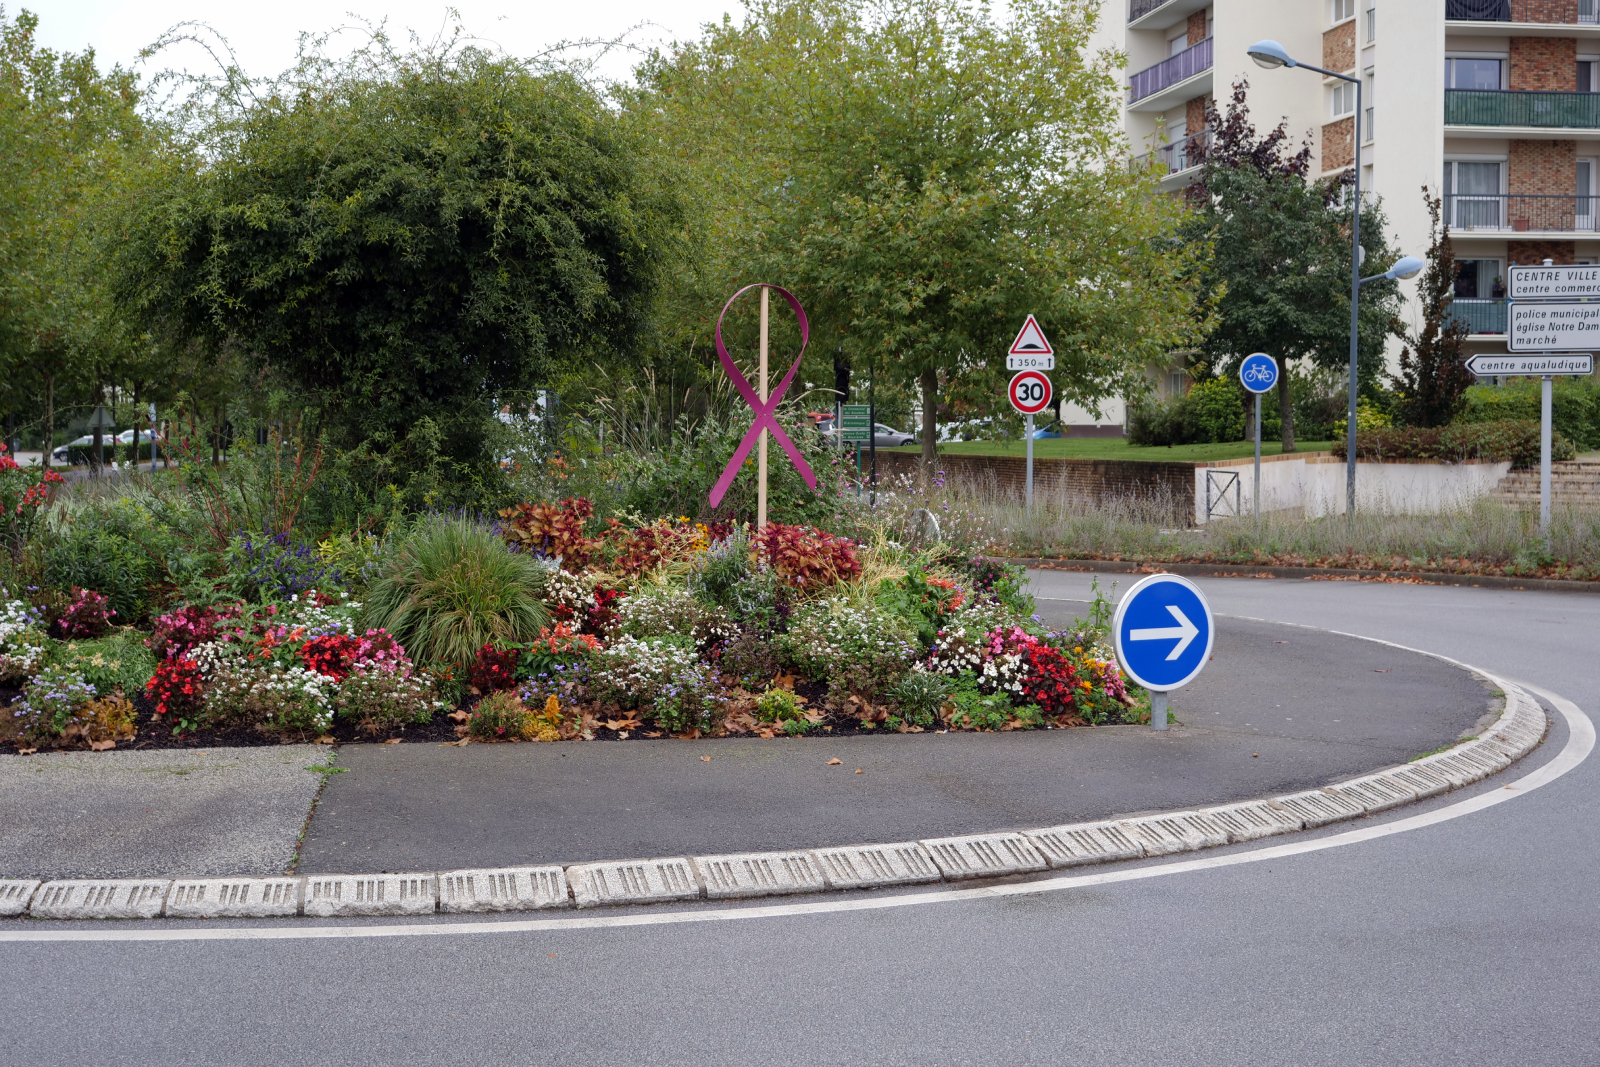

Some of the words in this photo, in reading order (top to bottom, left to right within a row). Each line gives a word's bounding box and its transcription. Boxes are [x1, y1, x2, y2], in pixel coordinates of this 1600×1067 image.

[1516, 271, 1560, 281] CENTRE
[1567, 270, 1598, 281] VILLE
[1516, 285, 1550, 294] centre
[1516, 309, 1547, 321] police
[1550, 308, 1600, 320] municipal
[1516, 322, 1545, 334] église
[1548, 322, 1575, 332] Notre
[1577, 321, 1600, 331] Dam
[1516, 335, 1557, 345] marché
[1480, 360, 1515, 370] centre
[1521, 360, 1587, 371] aqualudique
[1018, 383, 1043, 401] 30
